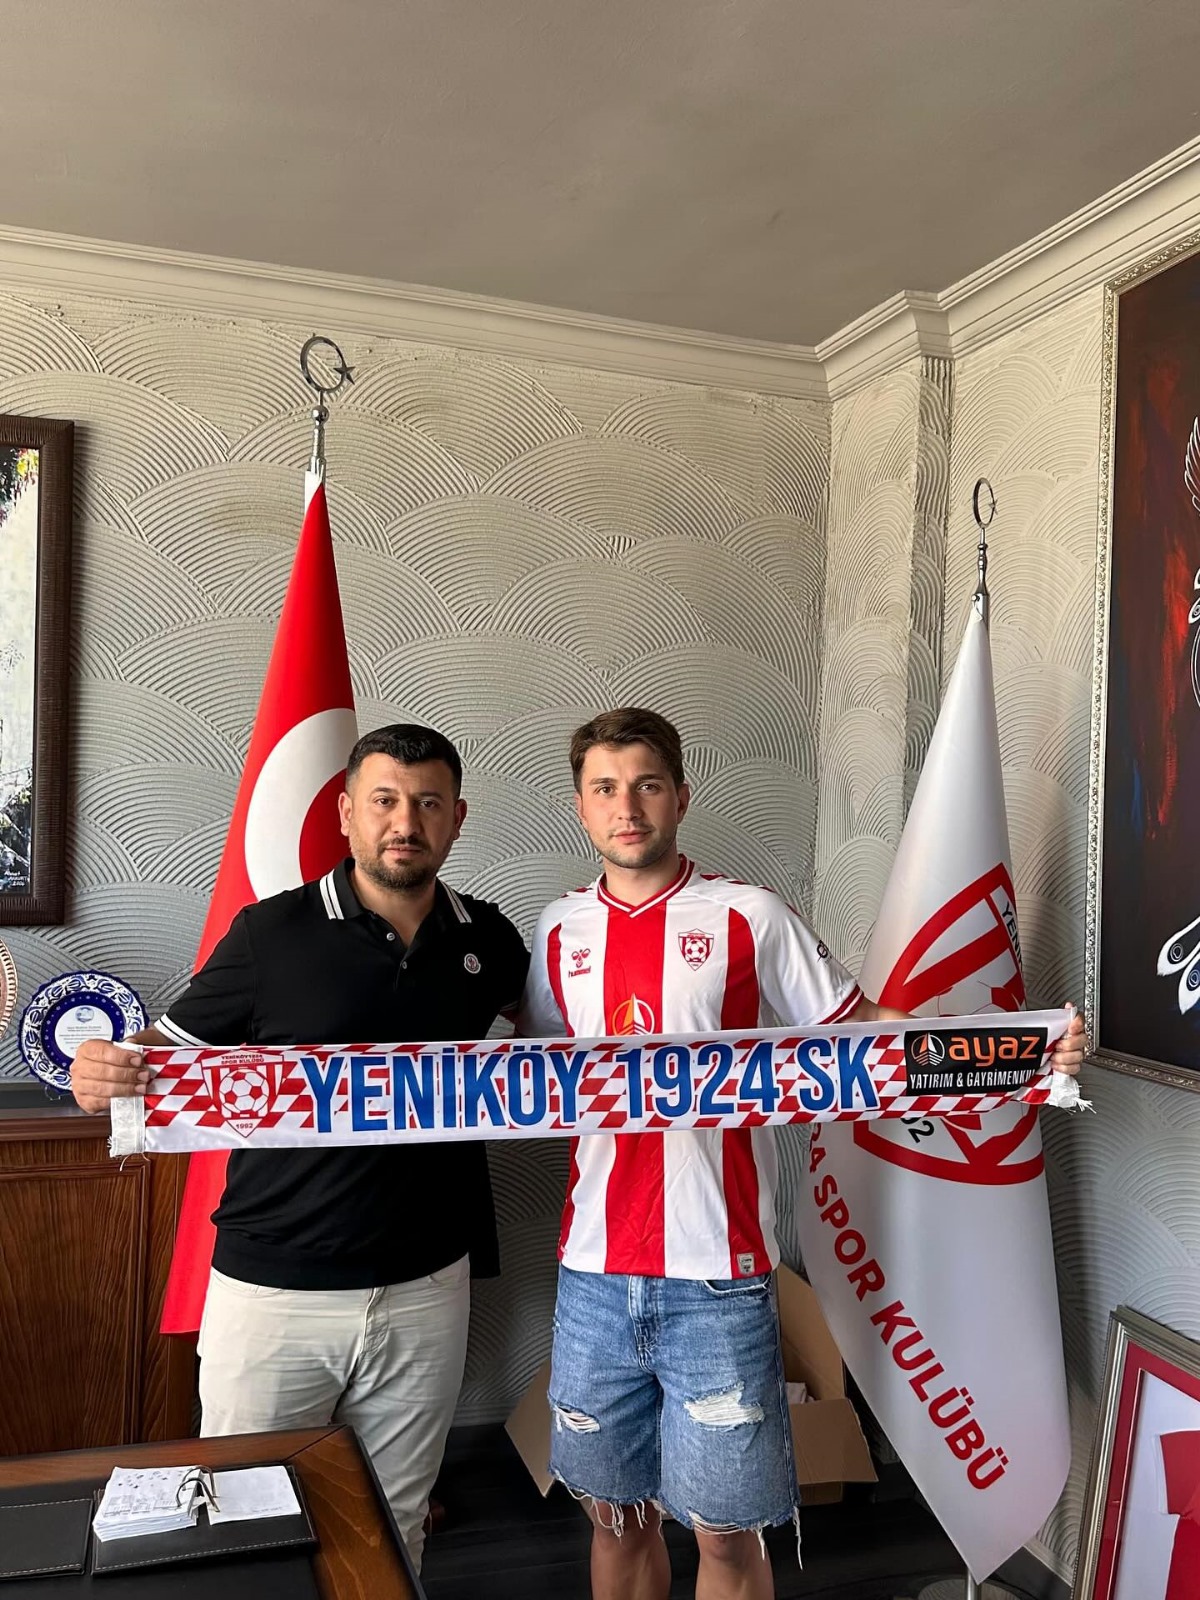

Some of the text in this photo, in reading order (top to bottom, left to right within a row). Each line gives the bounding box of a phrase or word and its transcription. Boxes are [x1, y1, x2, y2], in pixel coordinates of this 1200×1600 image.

[910, 1073, 953, 1090] YATIRIM
[956, 1072, 964, 1088] &
[948, 1036, 1040, 1067] ayaz
[301, 1037, 878, 1133] YENİKÖY 1924 SK
[814, 1174, 886, 1302] SPOR
[870, 1300, 1010, 1490] KULÜBÜ
